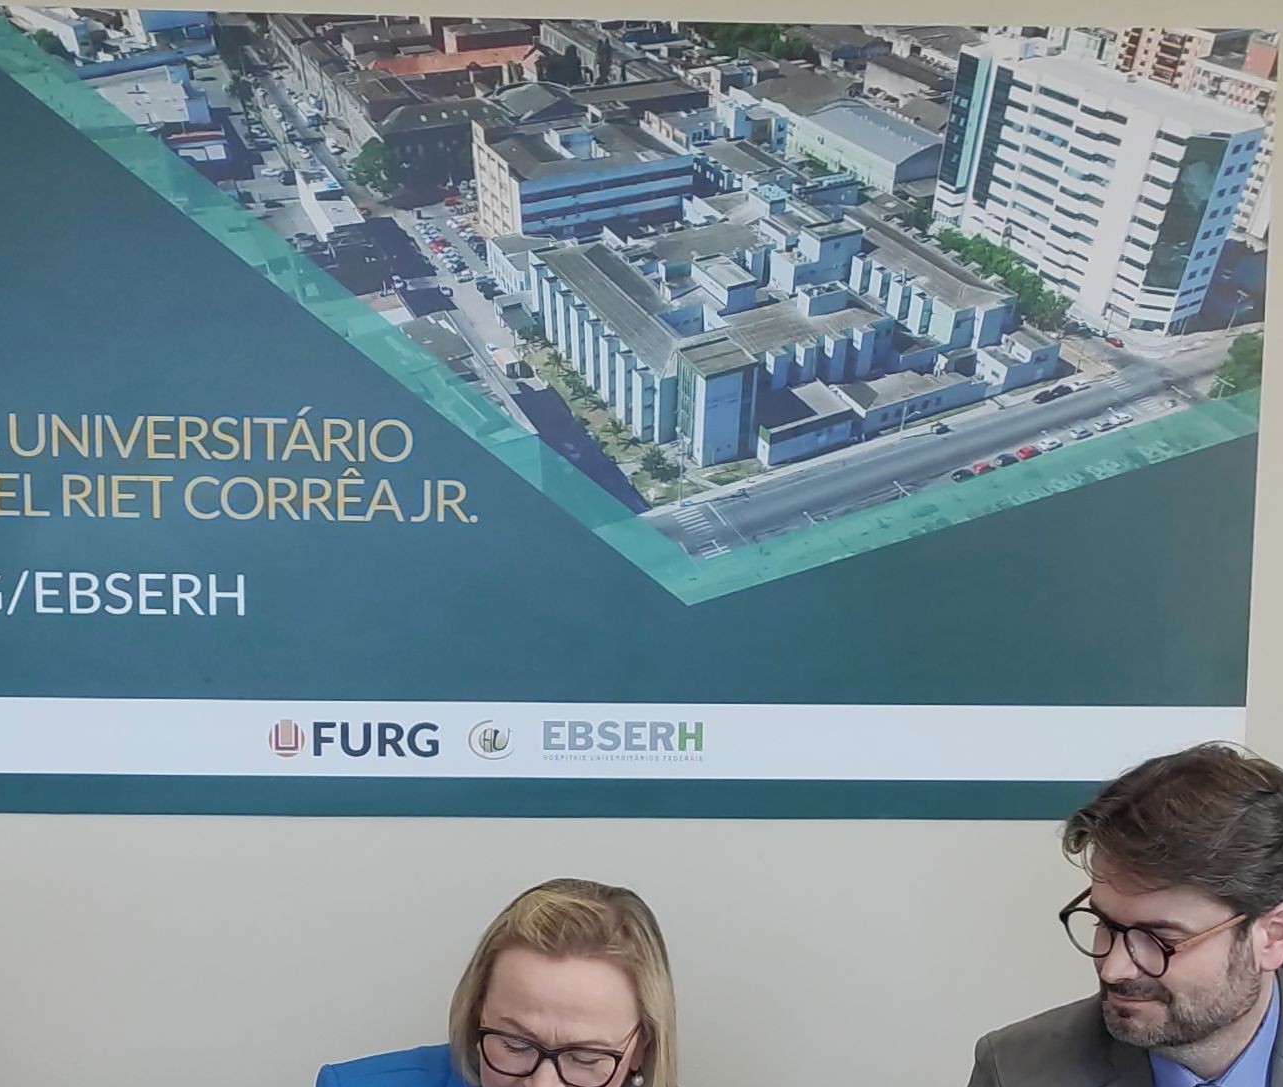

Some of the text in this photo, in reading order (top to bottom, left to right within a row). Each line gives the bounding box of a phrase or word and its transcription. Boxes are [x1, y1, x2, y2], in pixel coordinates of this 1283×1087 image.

[9, 406, 414, 463] UNIVERSITÁRIO
[63, 473, 174, 519] RIET
[184, 468, 405, 522] CORRÊA
[411, 479, 479, 523] JR.
[312, 721, 440, 758] FURG
[542, 720, 704, 751] EBSERH
